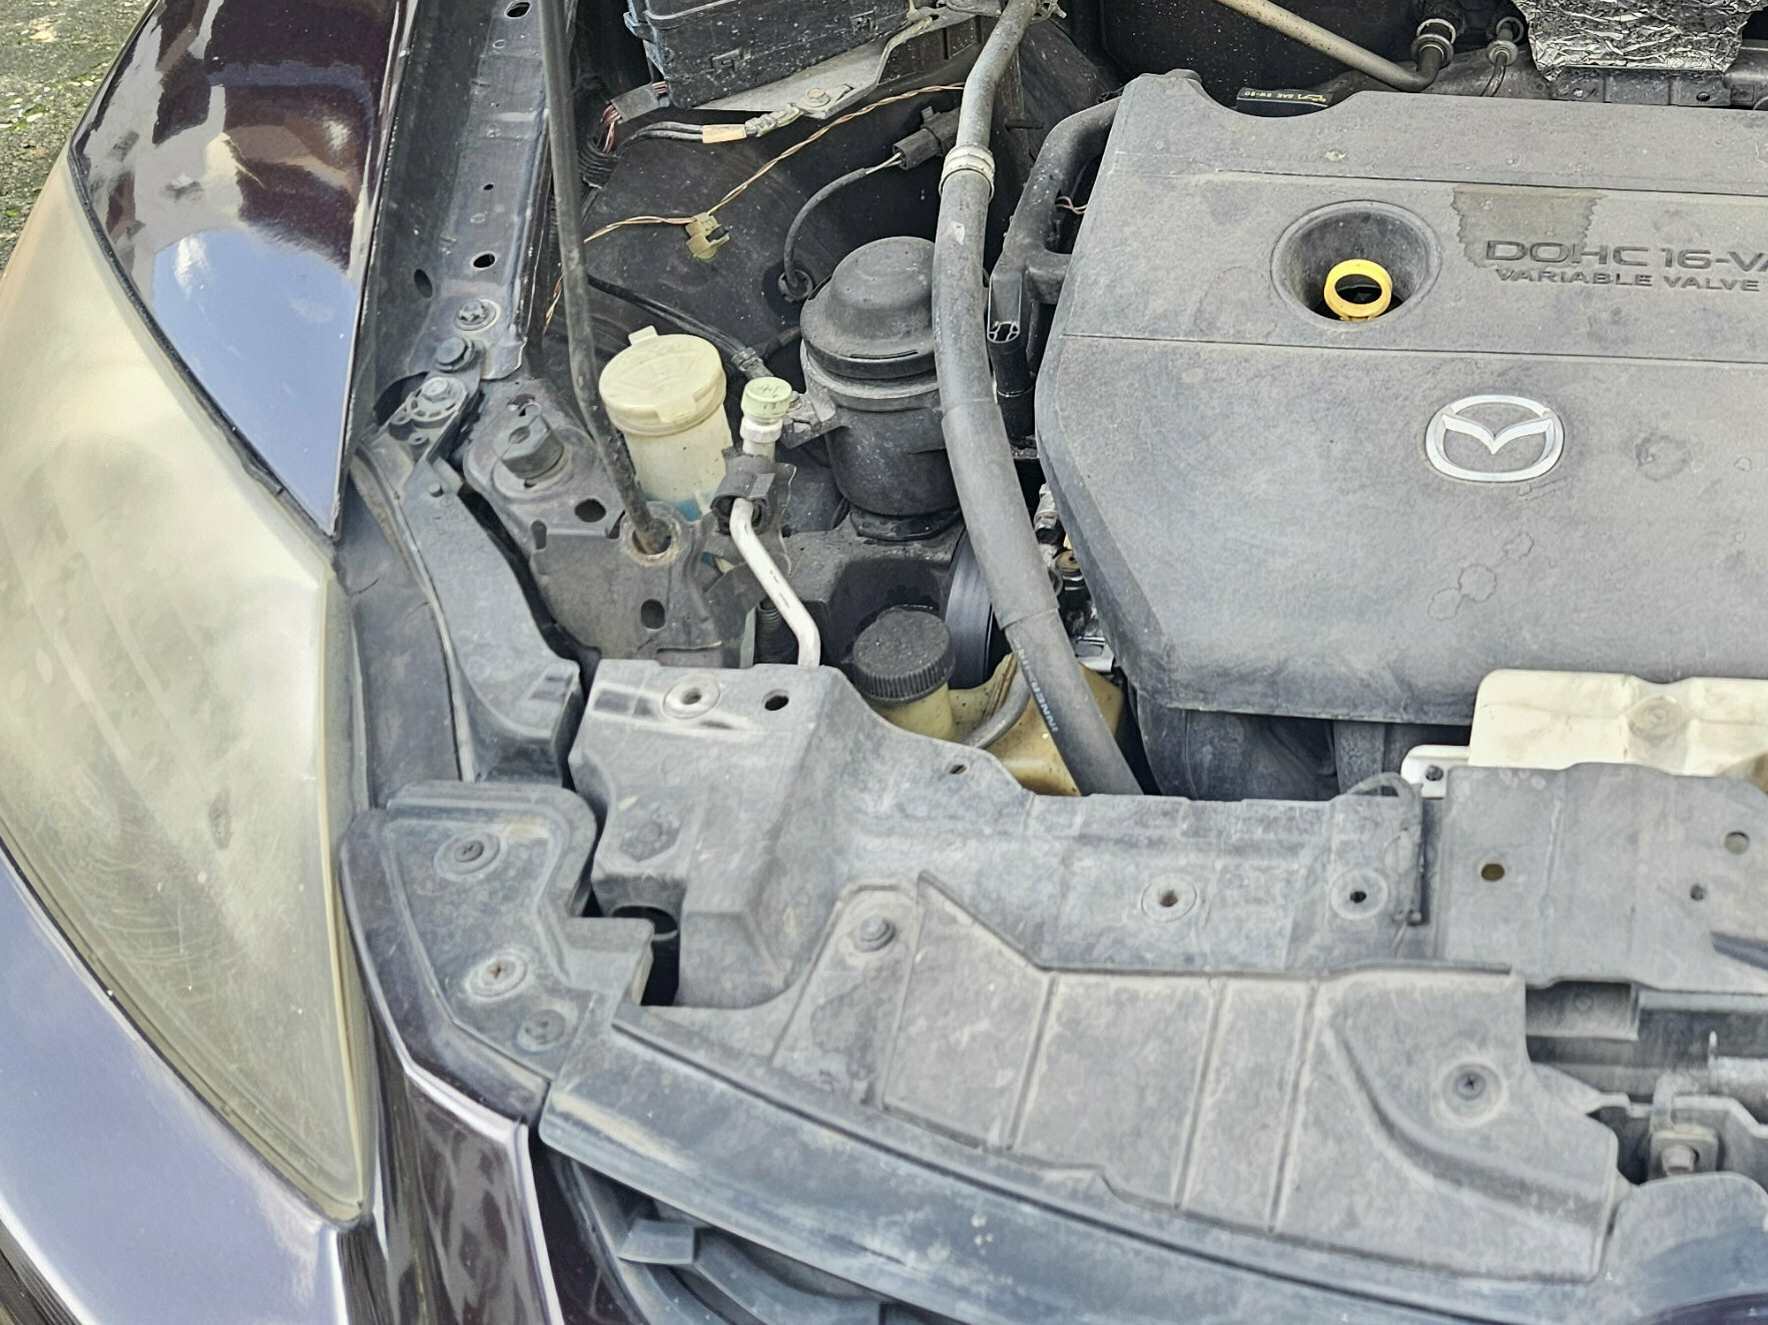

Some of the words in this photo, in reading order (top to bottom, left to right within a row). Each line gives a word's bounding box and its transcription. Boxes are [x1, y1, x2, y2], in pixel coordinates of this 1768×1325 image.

[1485, 240, 1648, 268] DOHC
[1496, 268, 1653, 287] VARIABLE
[1664, 274, 1760, 293] VALVE
